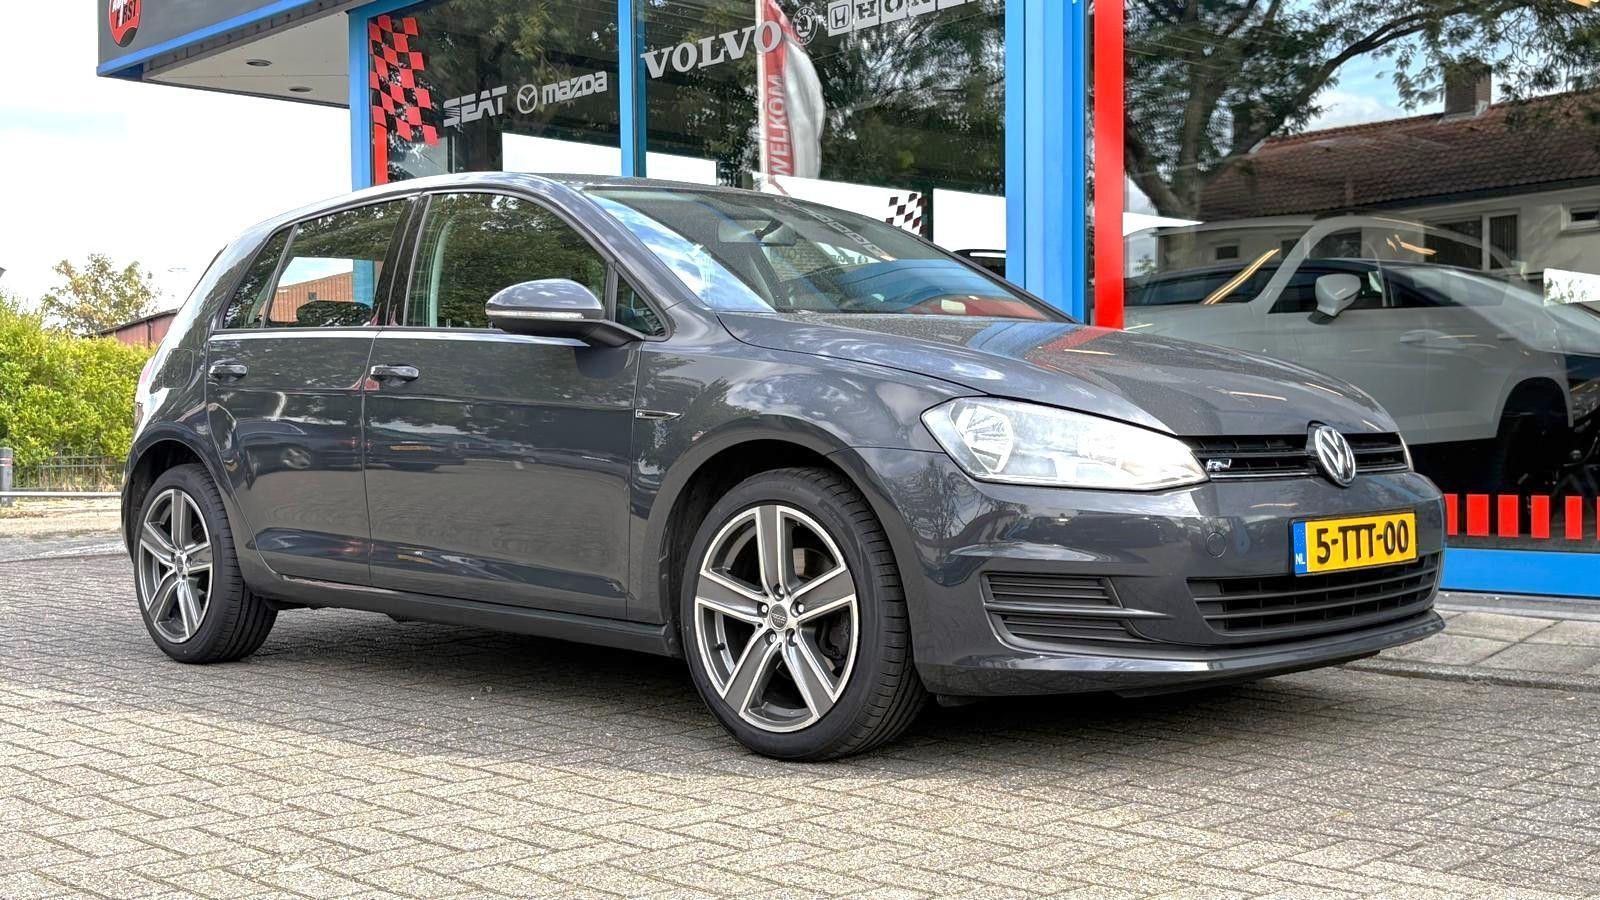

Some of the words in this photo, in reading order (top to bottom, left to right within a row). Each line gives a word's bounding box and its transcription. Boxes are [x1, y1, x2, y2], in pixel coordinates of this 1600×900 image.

[641, 20, 782, 79] VOLVO
[443, 85, 508, 127] SEAT
[767, 74, 791, 176] WELKOM
[1295, 553, 1306, 565] NL
[1316, 519, 1409, 565] 5-TTT-00
